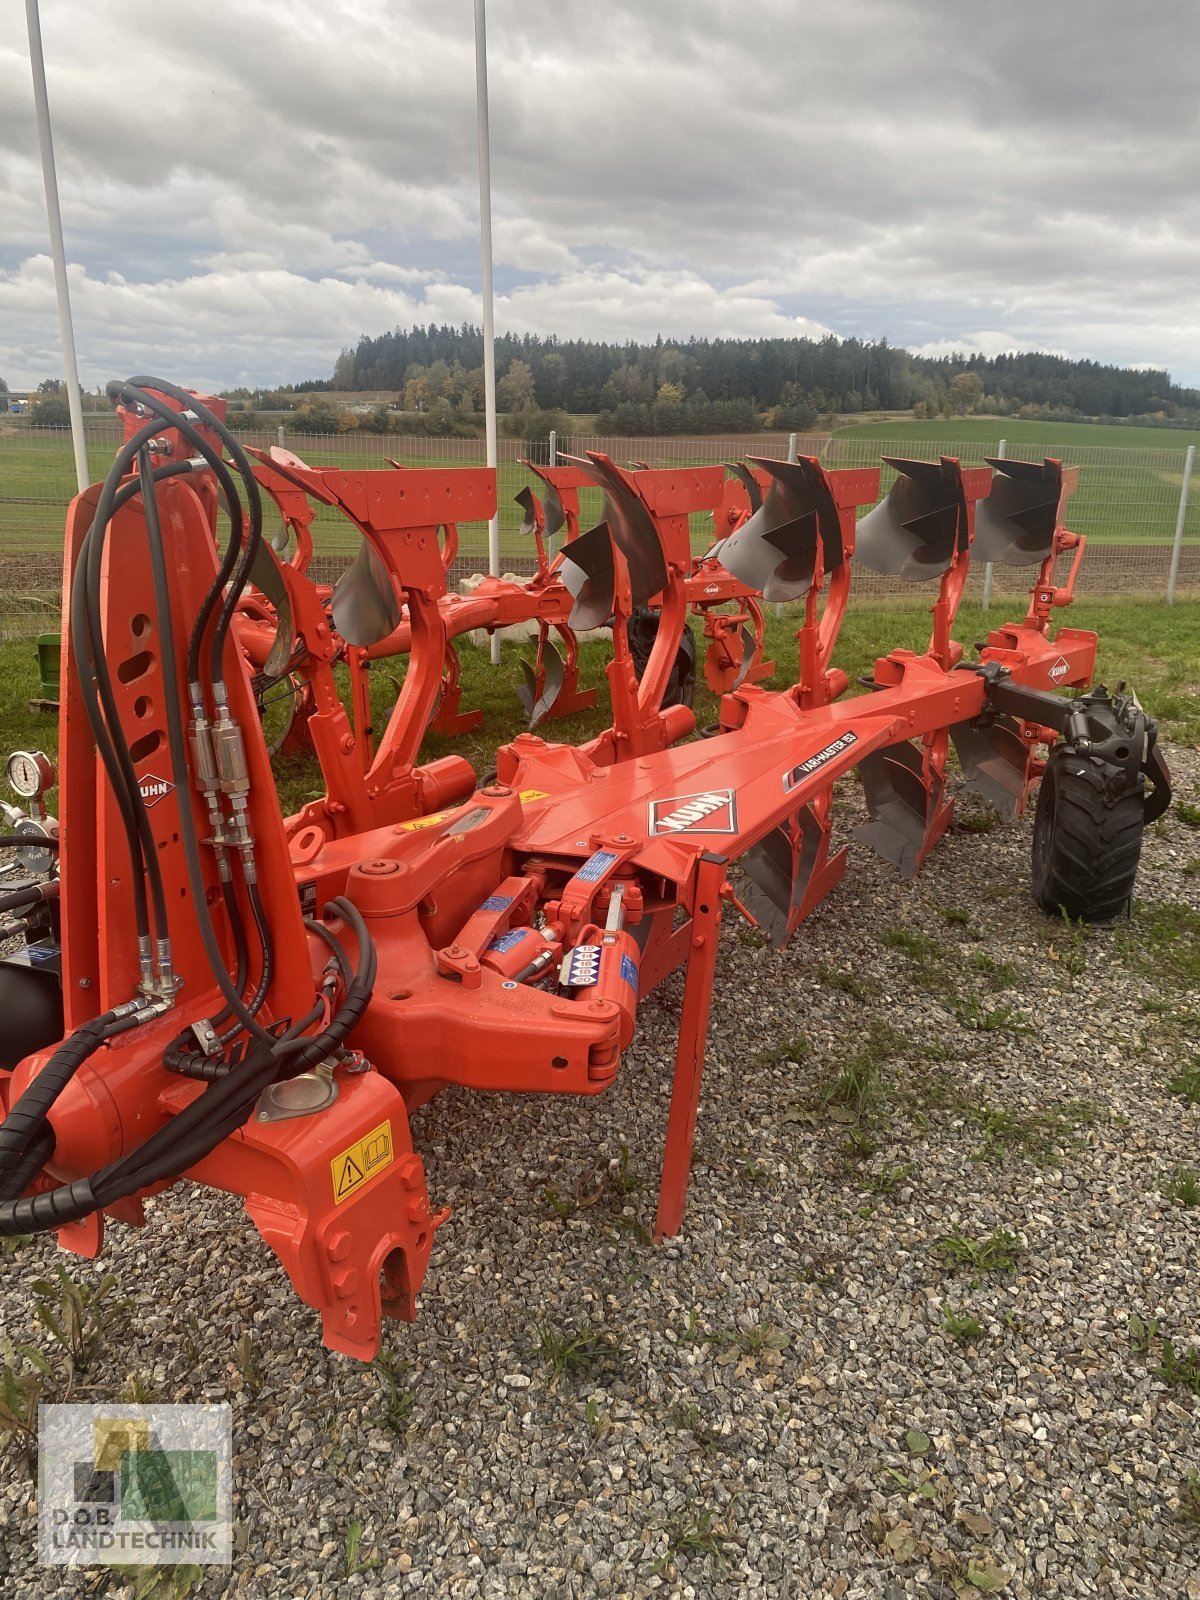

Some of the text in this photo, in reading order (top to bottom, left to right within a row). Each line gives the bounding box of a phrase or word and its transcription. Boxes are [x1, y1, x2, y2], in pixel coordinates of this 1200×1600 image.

[1051, 664, 1067, 677] KUHN
[798, 740, 847, 772] VARI-MASTER
[139, 782, 168, 798] UHN
[655, 793, 732, 831] KUHN
